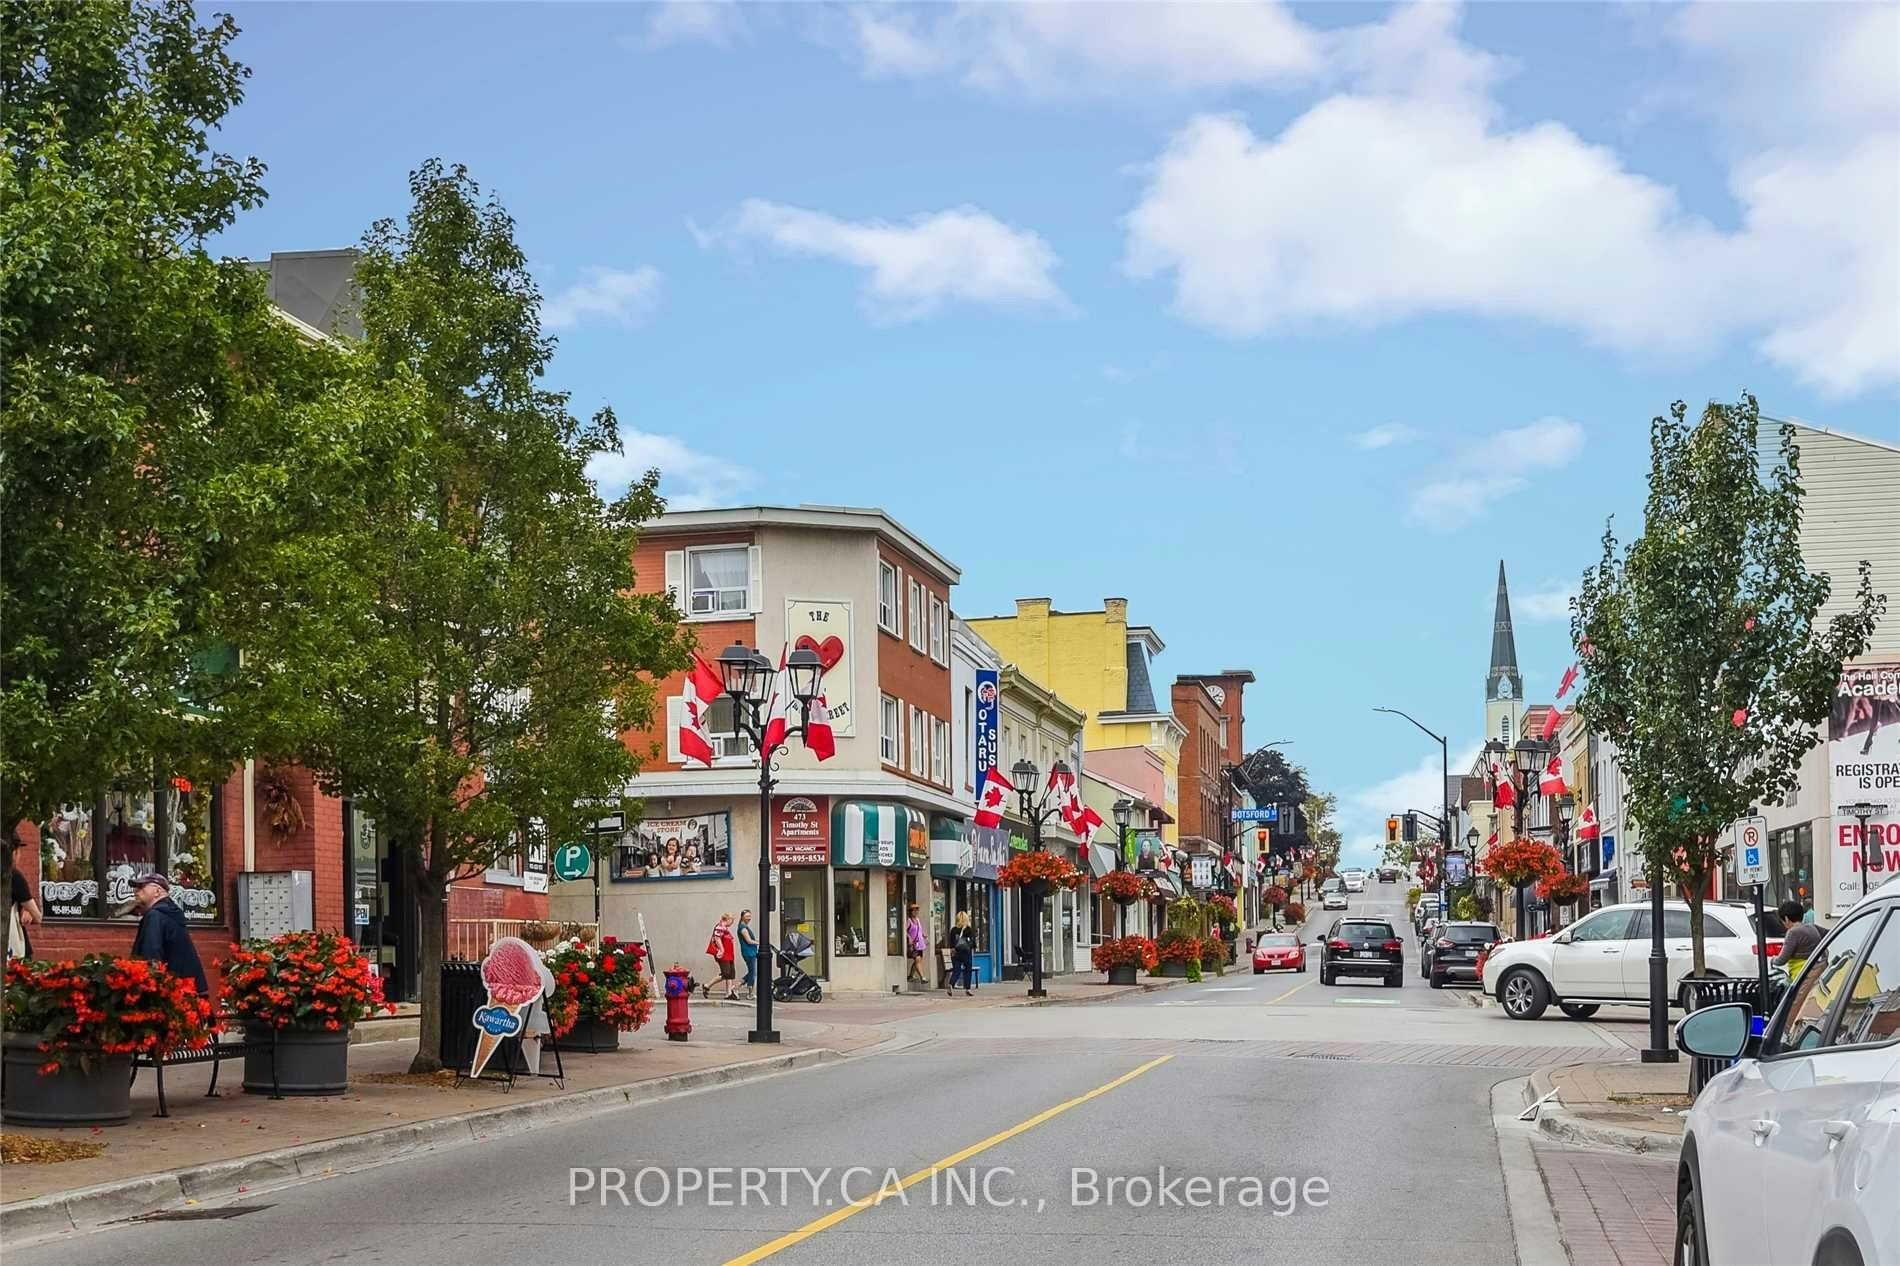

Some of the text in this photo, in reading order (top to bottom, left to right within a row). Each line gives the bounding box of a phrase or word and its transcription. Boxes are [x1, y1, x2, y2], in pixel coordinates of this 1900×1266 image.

[809, 611, 829, 622] THE
[1838, 680, 1900, 697] Acade
[828, 702, 850, 720] REET
[978, 709, 987, 772] OTARU
[988, 729, 996, 766] SUS
[1836, 763, 1900, 777] REGISTRA
[1859, 777, 1871, 789] IS
[1231, 810, 1270, 819] BOTSFORD
[781, 821, 808, 829] Timothy
[781, 829, 819, 837] Apartments
[565, 845, 581, 867] P
[478, 1011, 516, 1029] Kawartha
